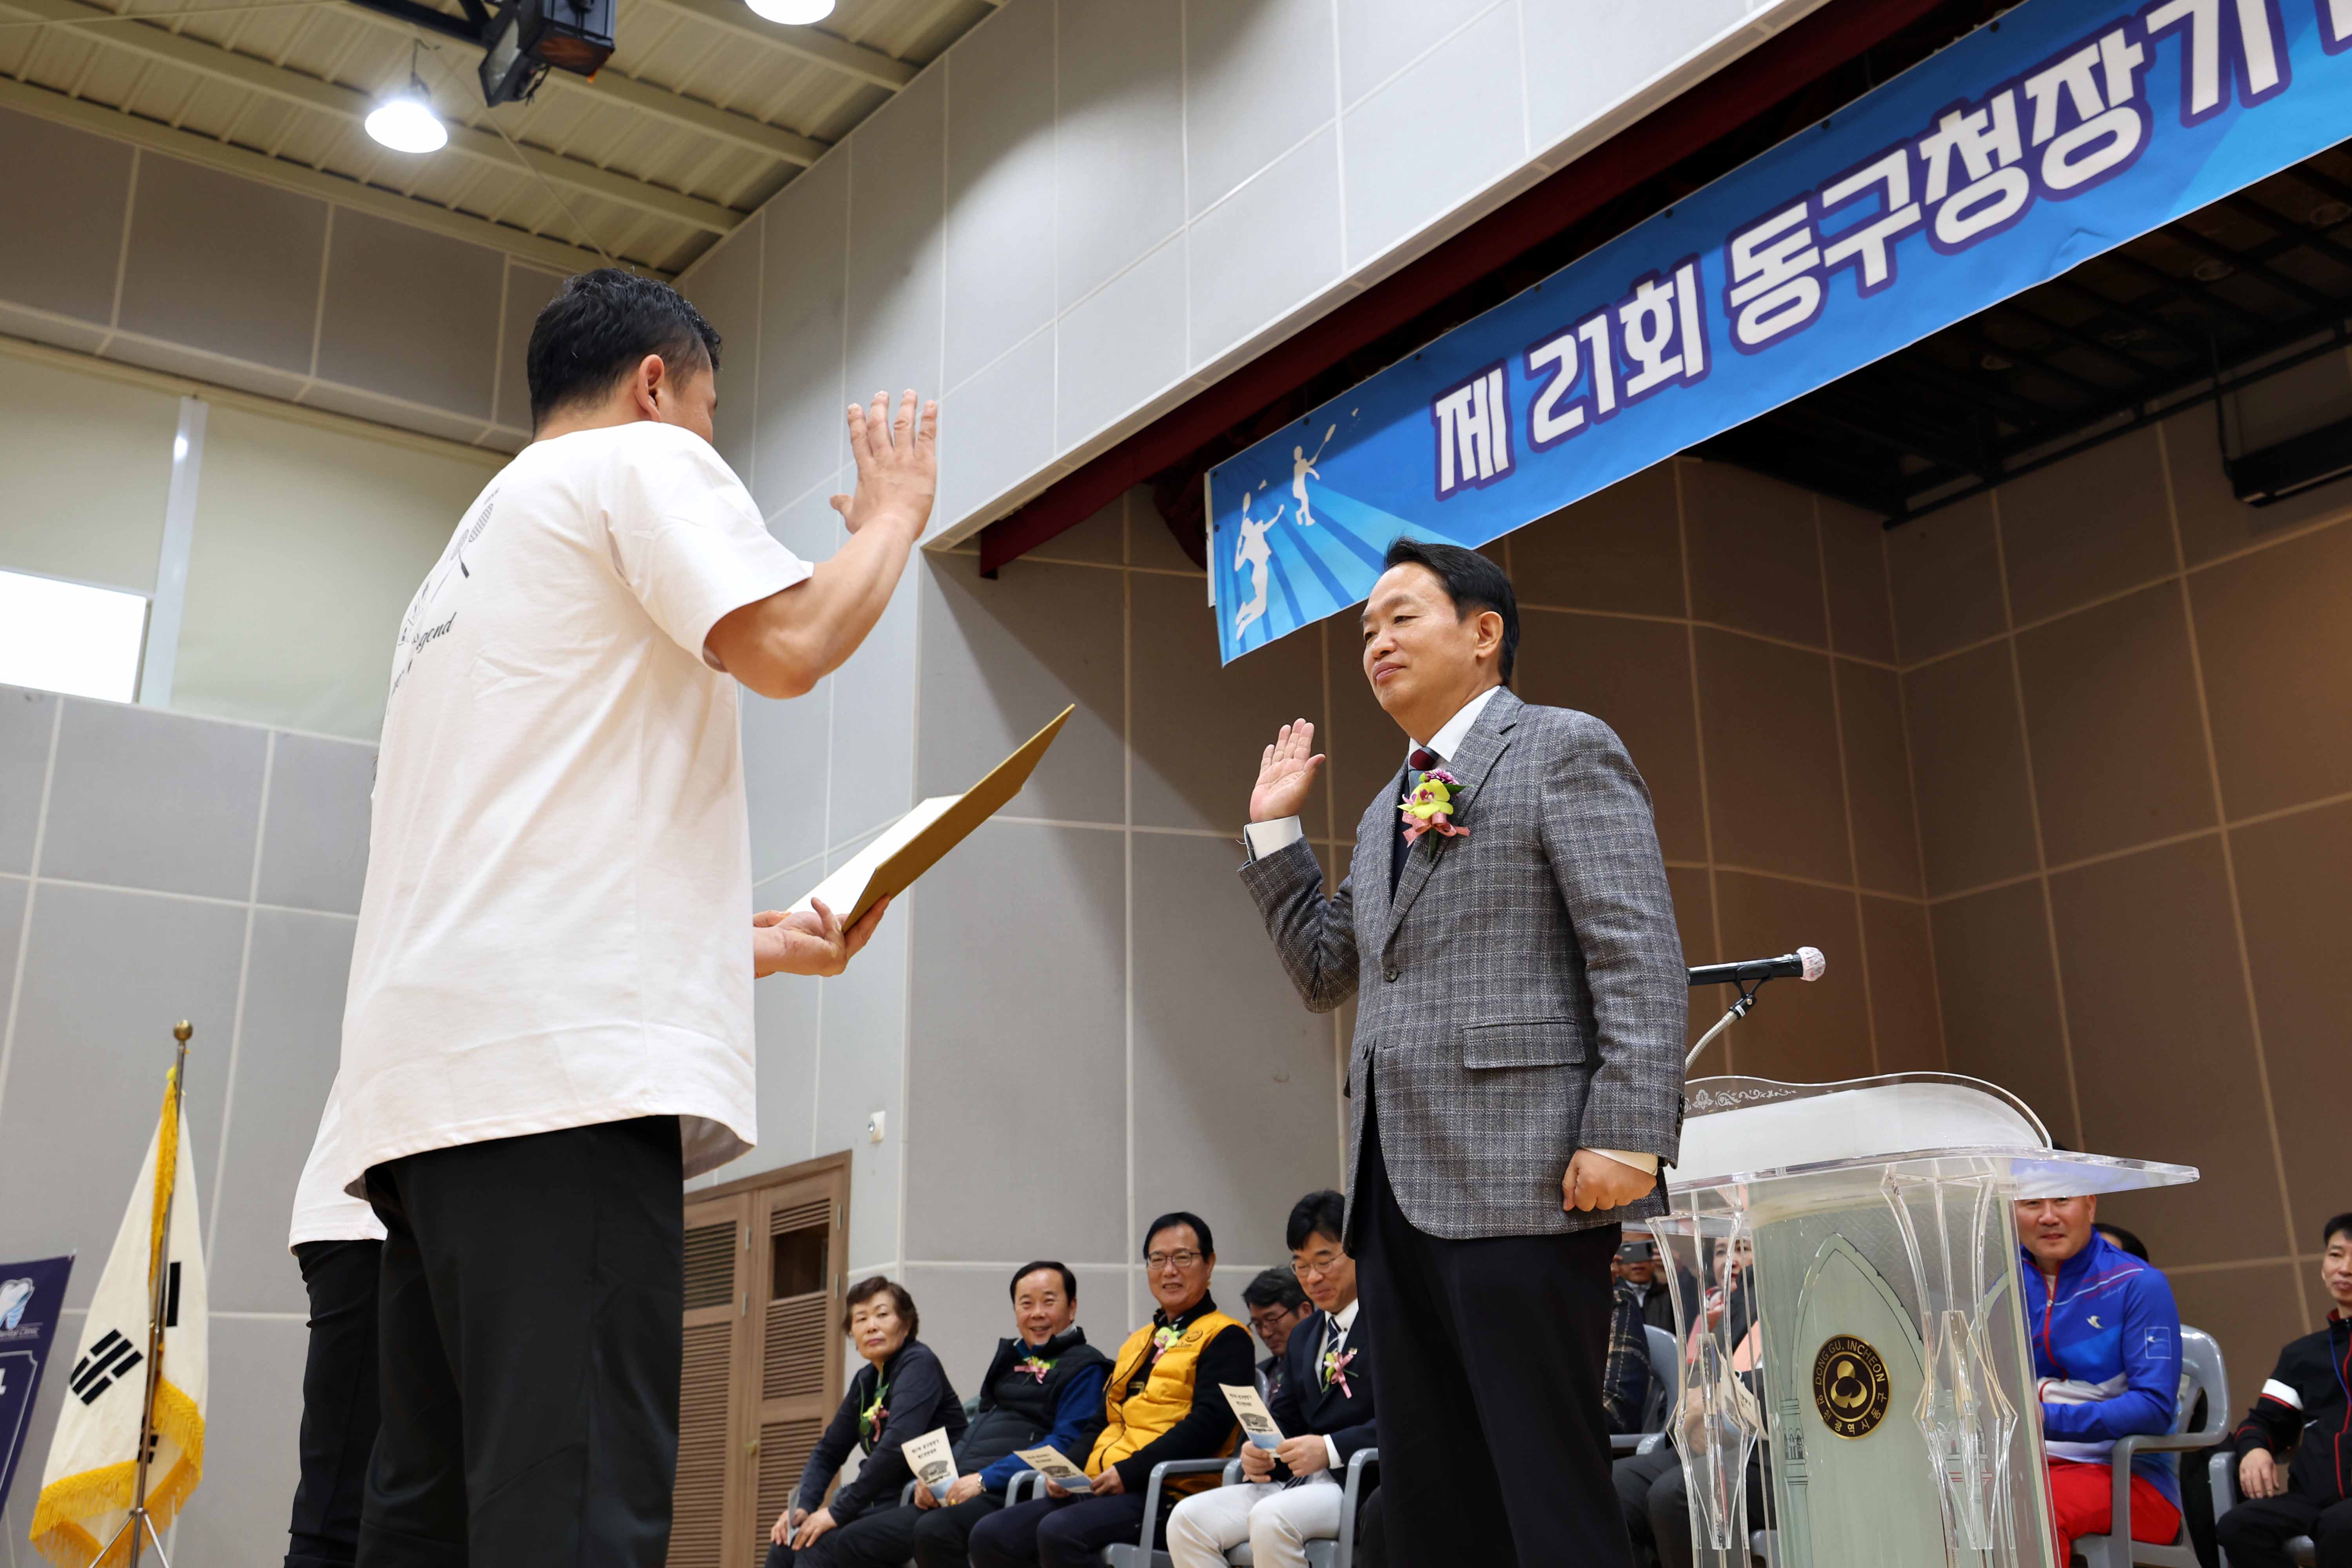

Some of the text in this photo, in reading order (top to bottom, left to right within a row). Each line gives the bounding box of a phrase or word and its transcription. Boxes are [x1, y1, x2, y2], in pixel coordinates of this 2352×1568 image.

[1436, 0, 2279, 492] 제 21회 동구청장기
[1815, 1350, 1829, 1385] DONG
[1847, 1339, 1886, 1383] INCHEON
